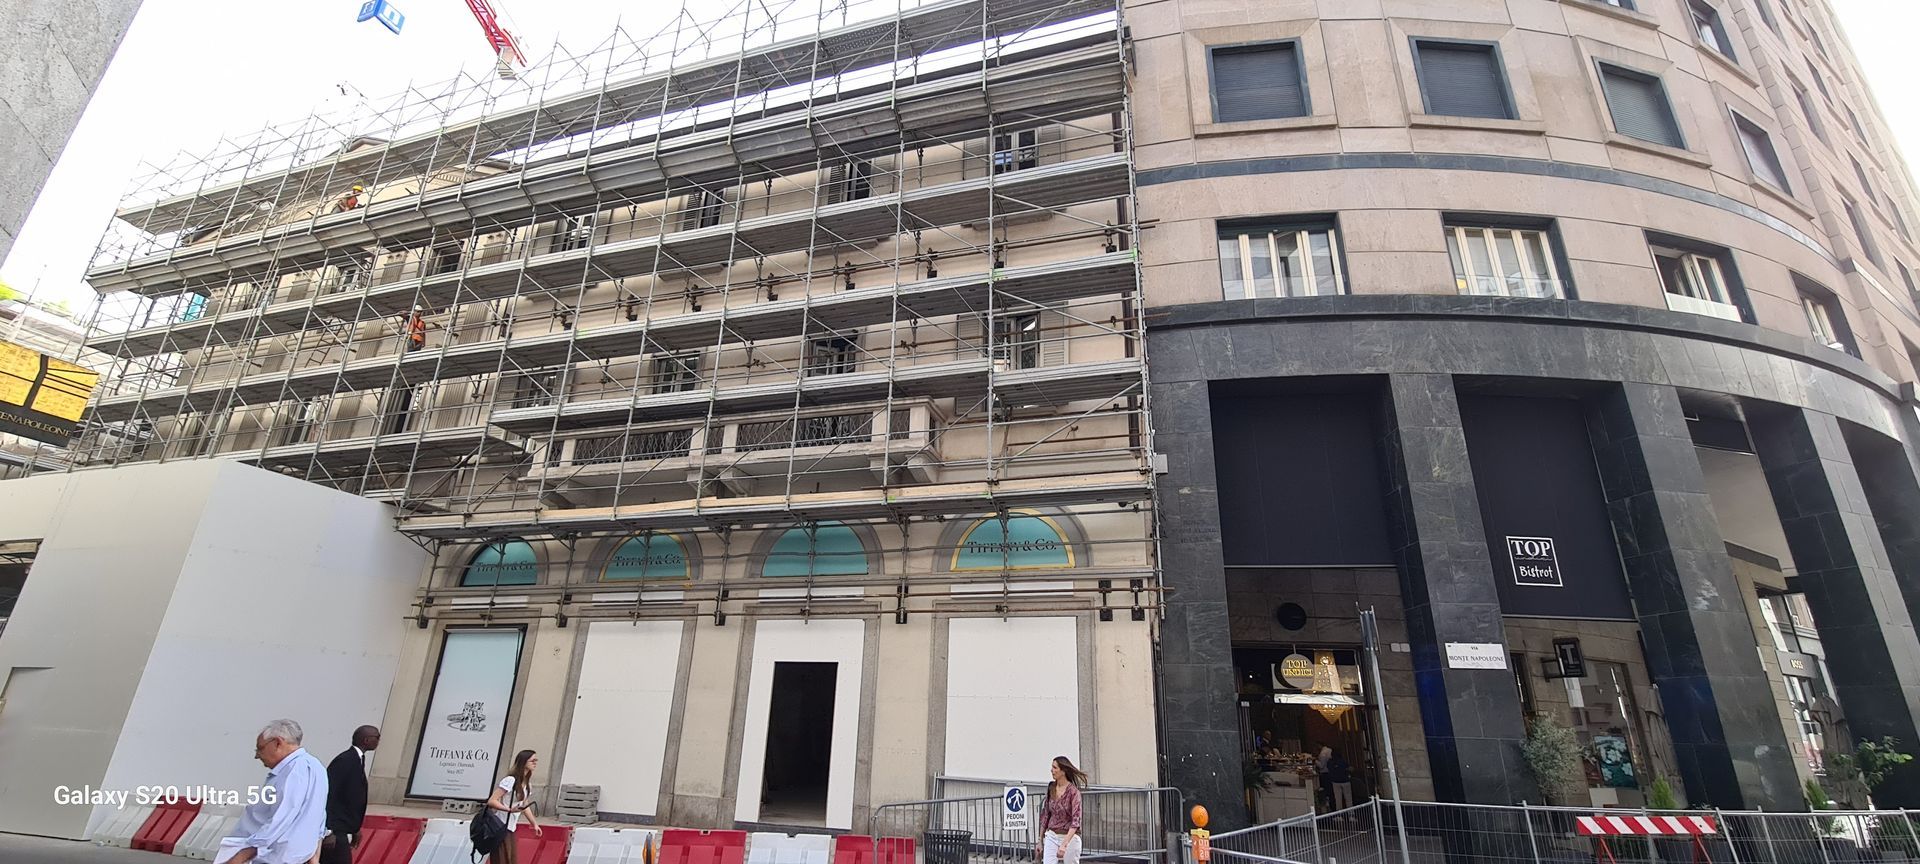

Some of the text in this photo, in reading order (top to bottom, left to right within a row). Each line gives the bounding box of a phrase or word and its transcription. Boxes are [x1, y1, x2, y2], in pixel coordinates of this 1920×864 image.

[0, 411, 72, 437] ENAPOLEONE
[1511, 540, 1550, 557] TOP
[1519, 565, 1553, 579] Bistrot
[1286, 660, 1308, 669] TOP
[430, 746, 466, 760] TIFFANY
